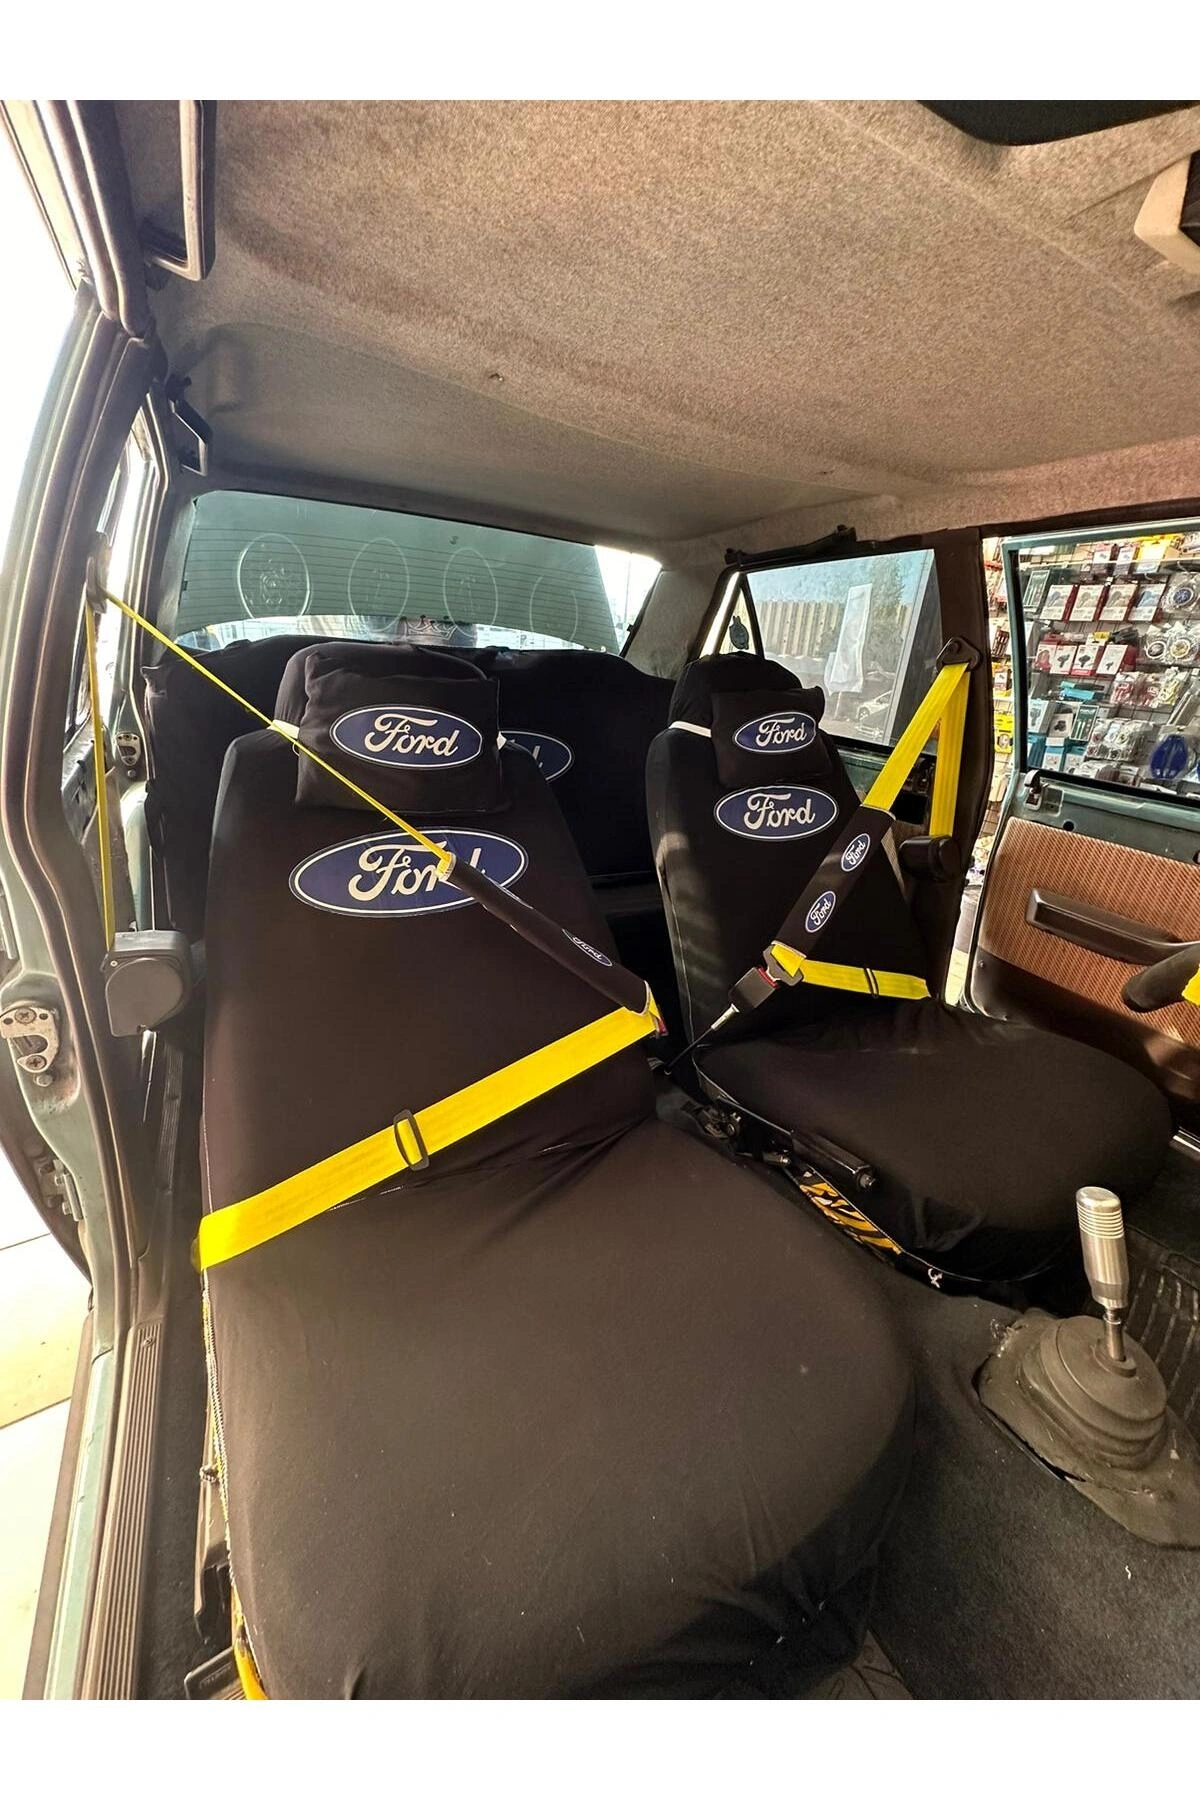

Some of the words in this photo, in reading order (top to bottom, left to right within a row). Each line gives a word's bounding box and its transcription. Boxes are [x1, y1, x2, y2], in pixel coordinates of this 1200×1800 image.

[364, 712, 460, 757] Ford
[755, 717, 807, 747] Ford
[743, 793, 815, 830] Ford
[845, 839, 866, 865] Ford
[810, 898, 832, 925] Ford
